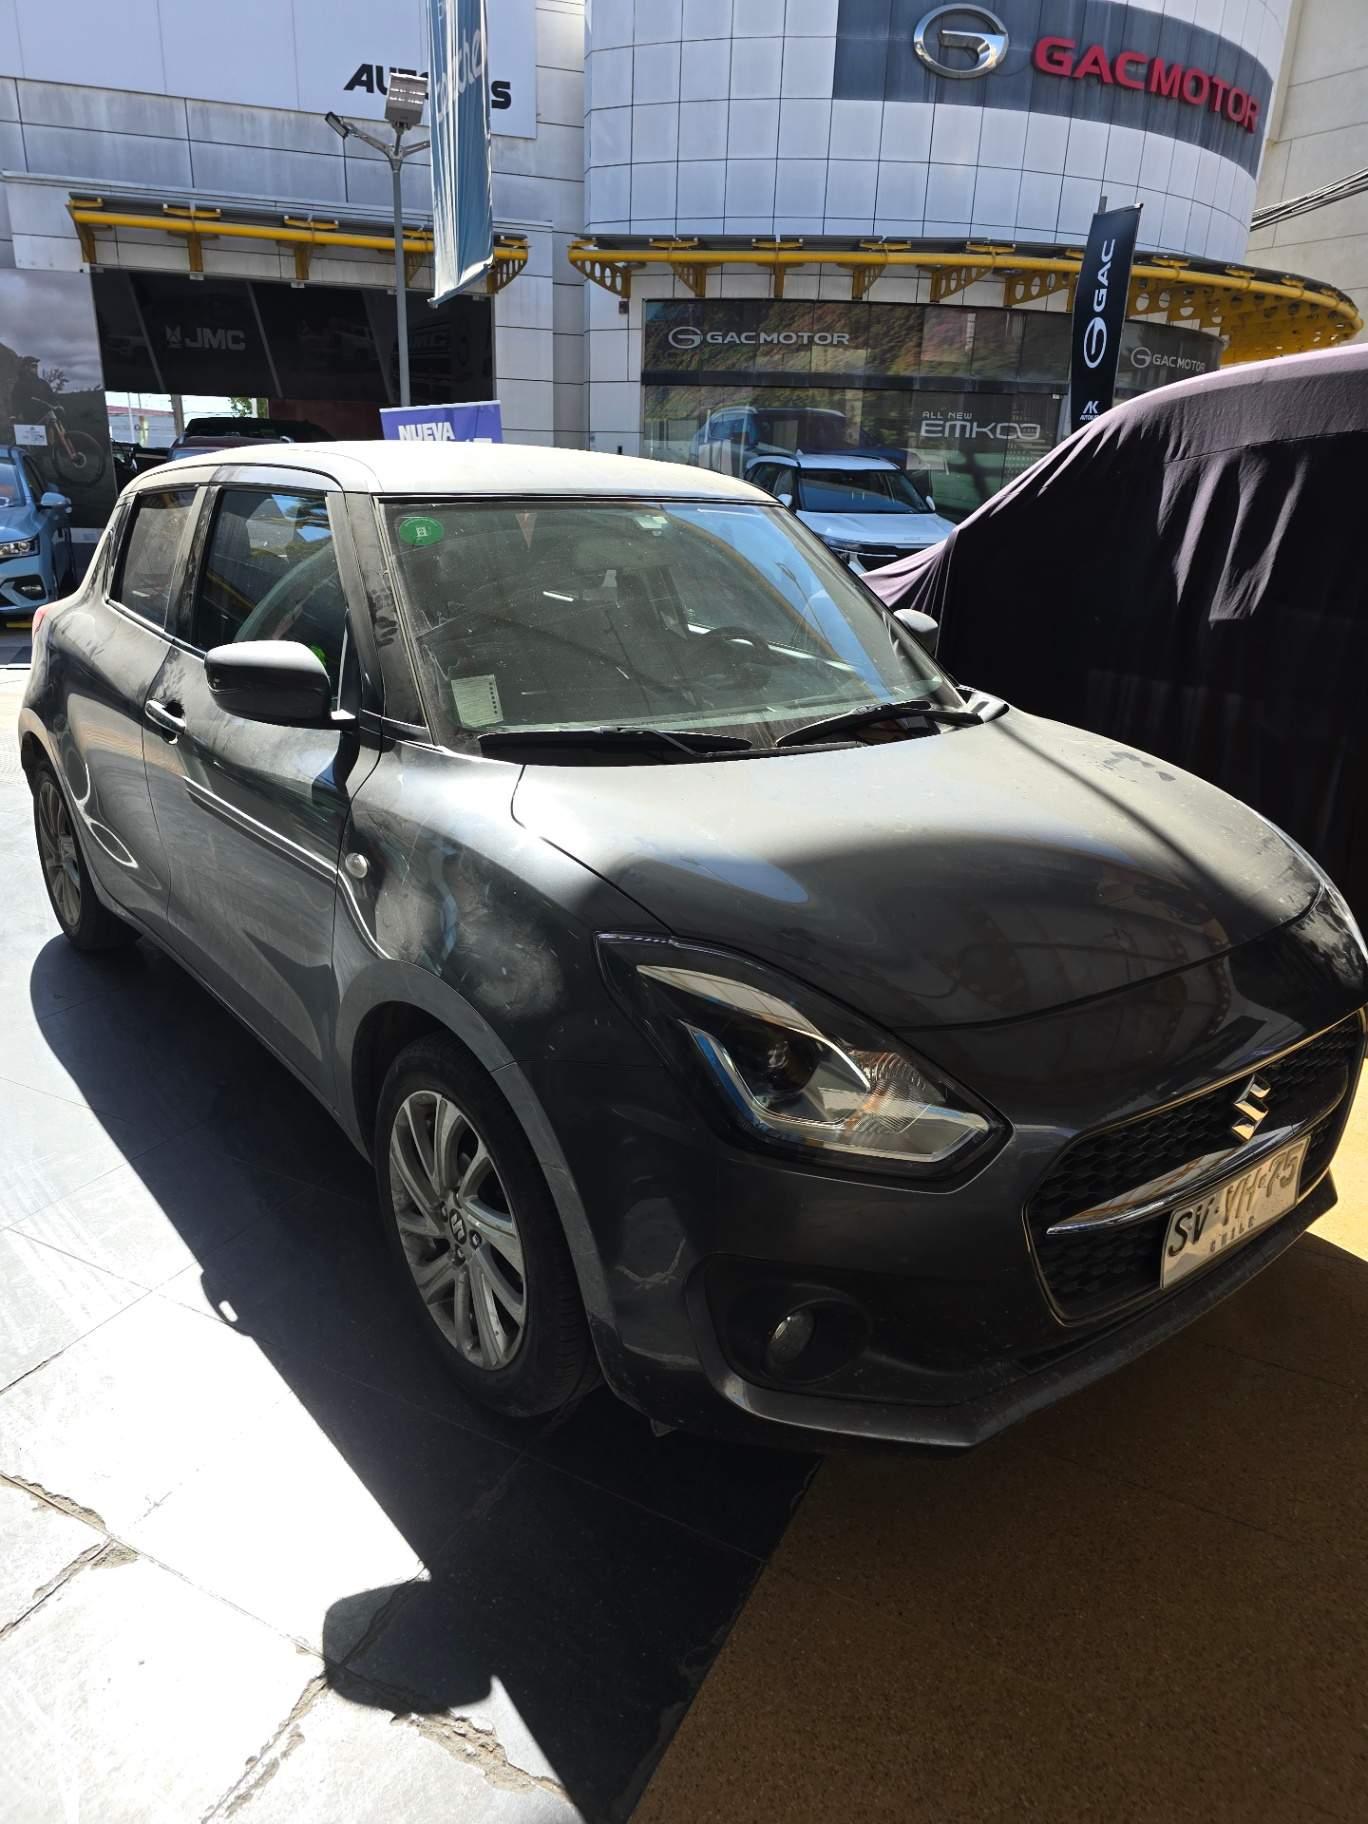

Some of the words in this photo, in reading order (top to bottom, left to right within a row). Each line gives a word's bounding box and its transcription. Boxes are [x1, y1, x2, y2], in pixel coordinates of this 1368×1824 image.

[1093, 238, 1116, 313] GAC
[184, 327, 246, 351] JMC
[922, 411, 943, 419] ALL
[948, 412, 973, 420] NEW
[398, 421, 456, 442] NUEVA
